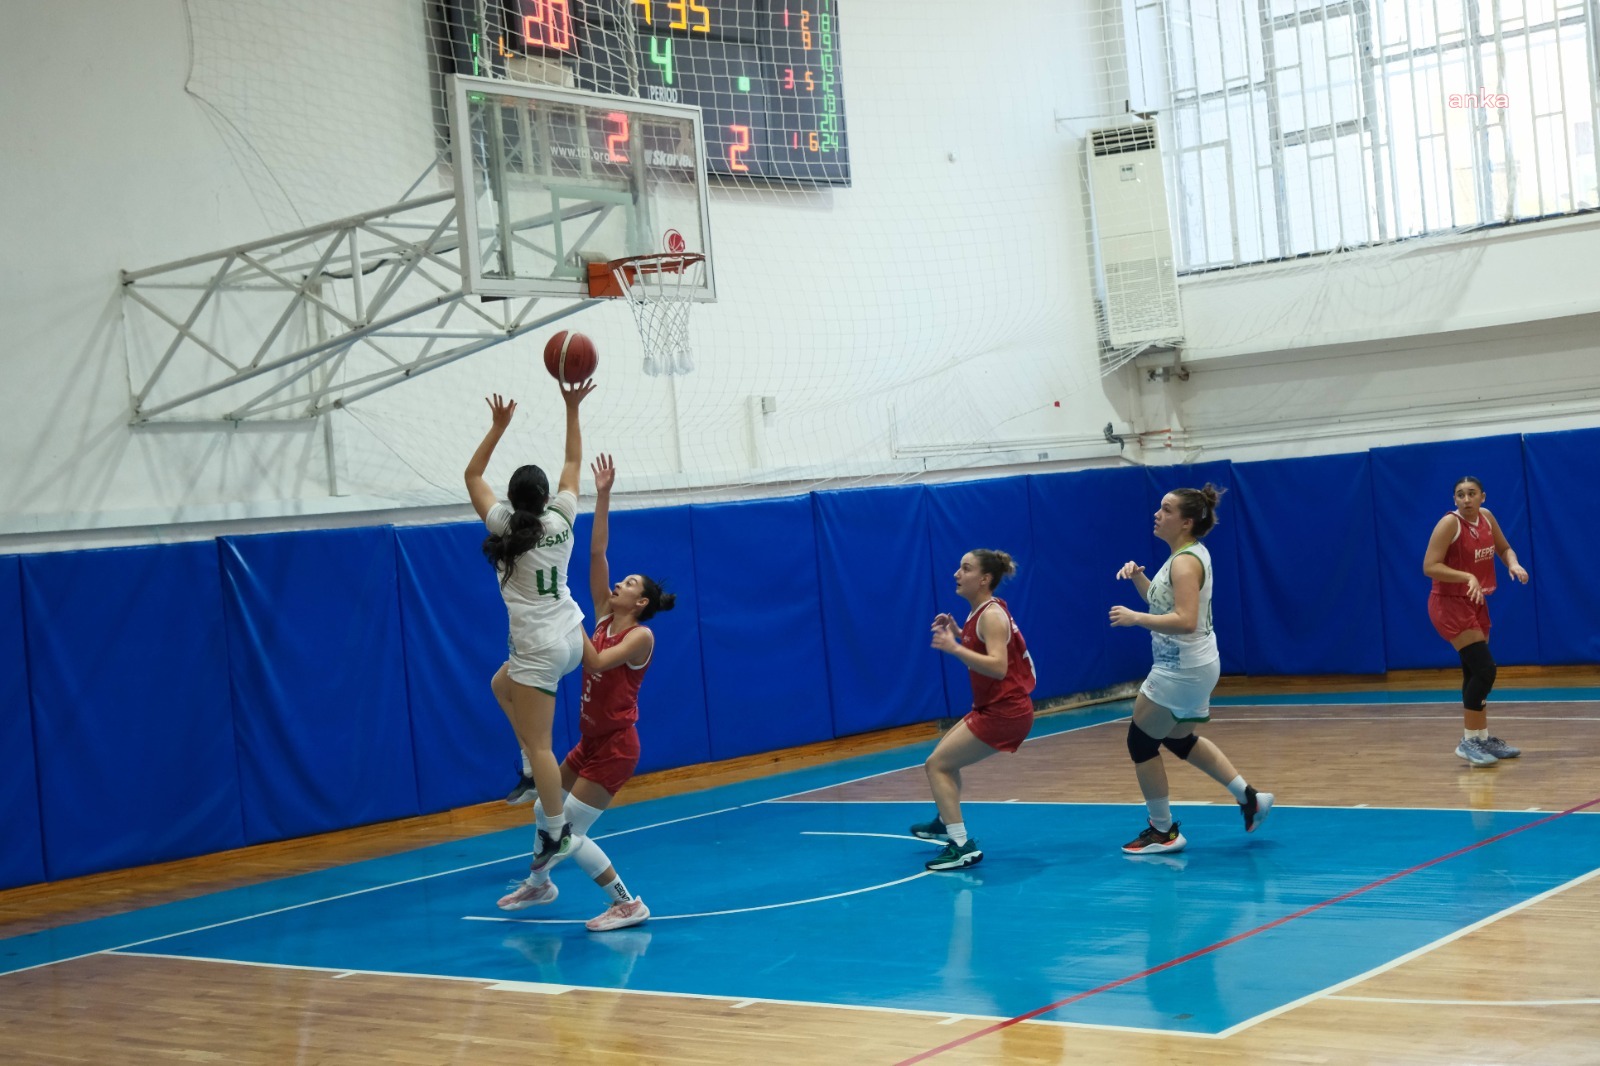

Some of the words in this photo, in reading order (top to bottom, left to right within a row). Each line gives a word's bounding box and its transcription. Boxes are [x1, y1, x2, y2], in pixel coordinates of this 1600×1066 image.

[651, 36, 673, 85] 4
[649, 86, 678, 103] PERIOD
[784, 68, 794, 89] 3
[607, 112, 628, 163] 2
[730, 125, 749, 171] 2
[809, 132, 818, 152] 6
[822, 133, 838, 152] 24
[535, 565, 560, 600] 4
